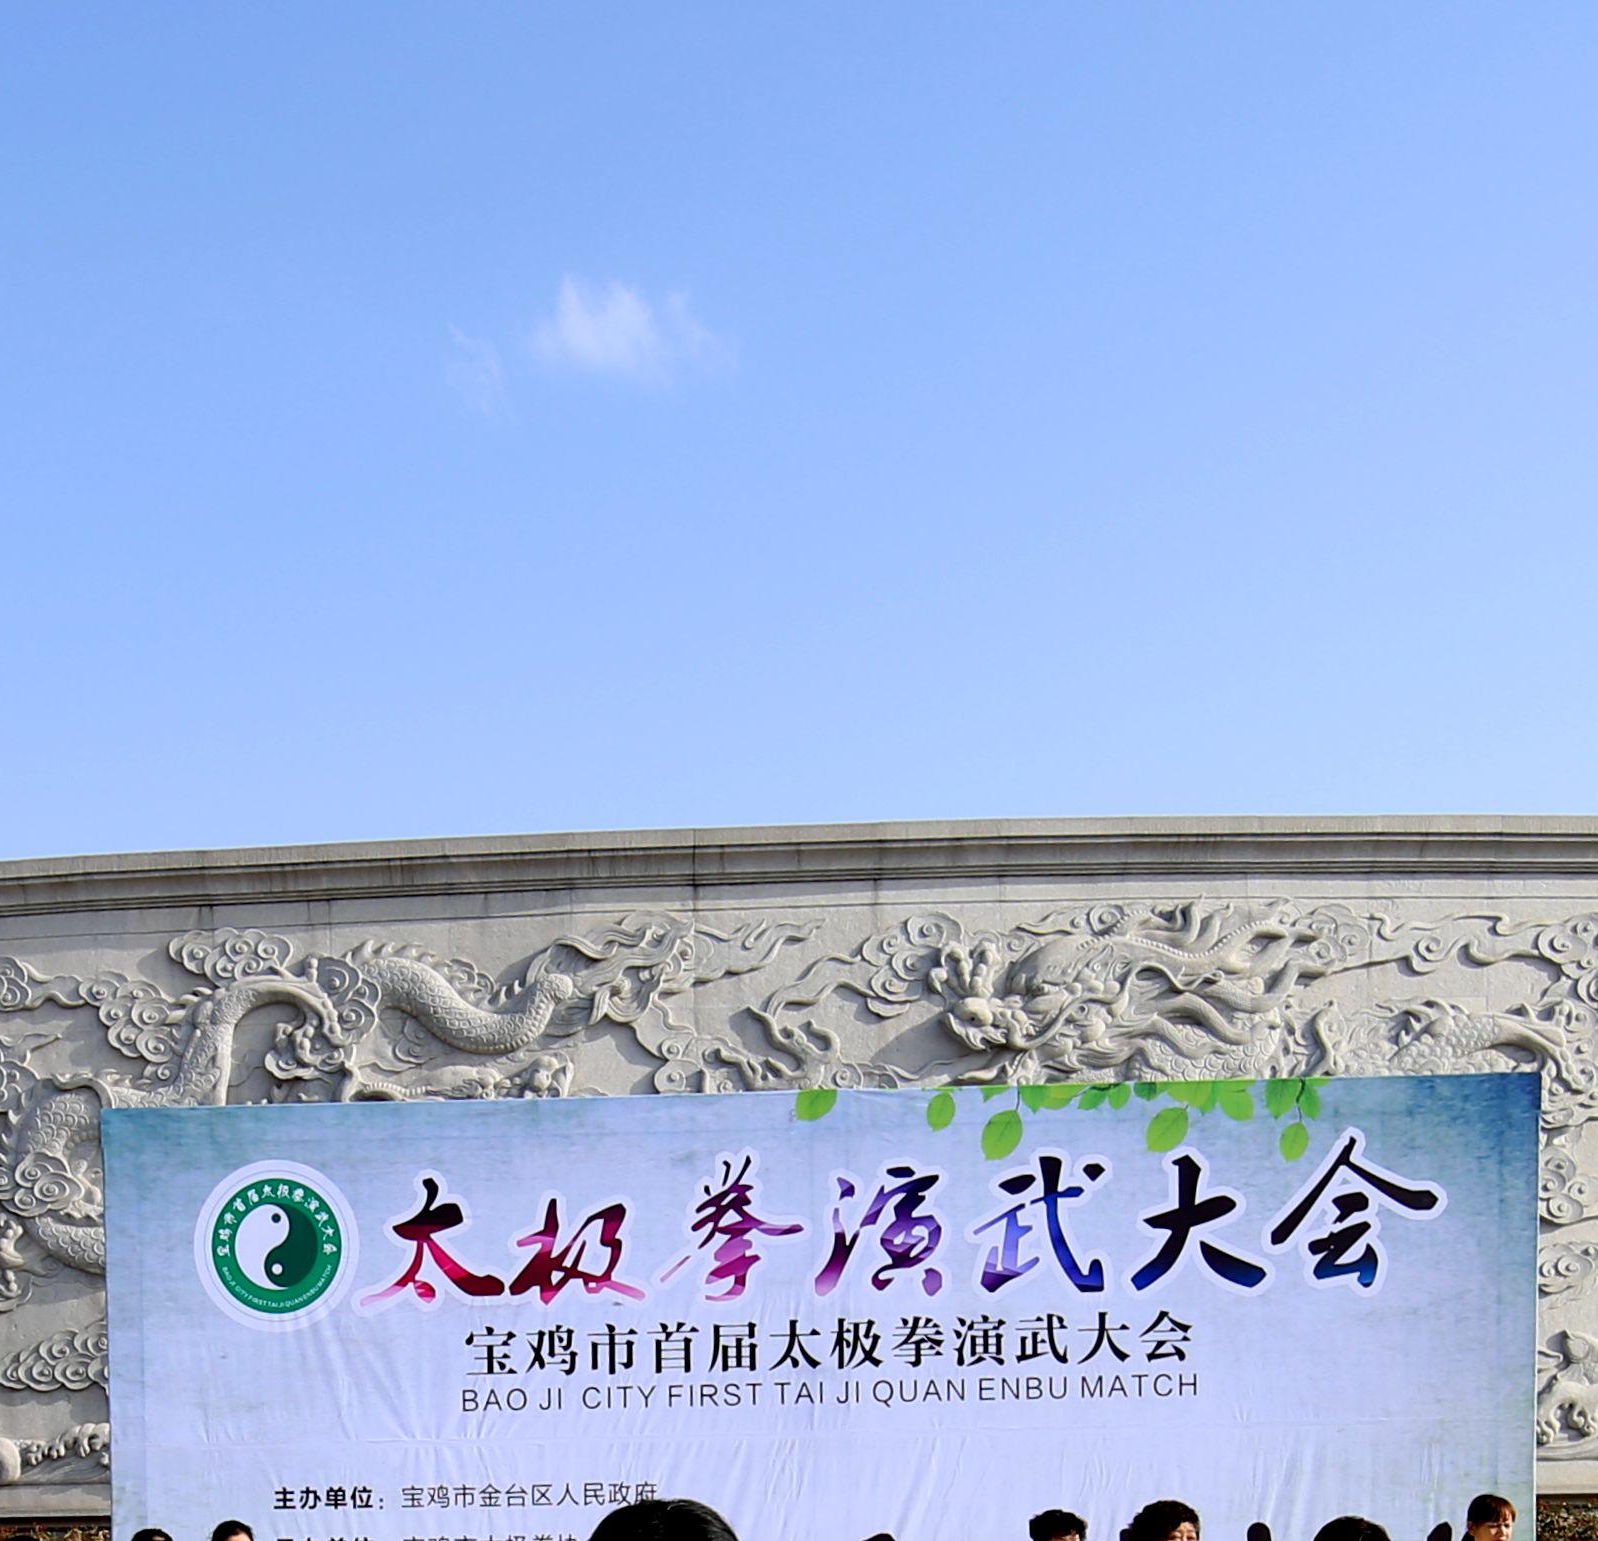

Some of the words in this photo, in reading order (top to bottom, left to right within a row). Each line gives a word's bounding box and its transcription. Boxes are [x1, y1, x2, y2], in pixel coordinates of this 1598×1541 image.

[360, 1136, 1439, 1306] 太极拳演武大会
[465, 1310, 1193, 1376] 宝鸡市首届太极拳演武大会
[462, 1388, 528, 1412] BAO
[539, 1387, 562, 1411] JI
[582, 1384, 656, 1410] CITY
[668, 1382, 763, 1408] FIRST
[774, 1381, 824, 1406] TAI
[837, 1380, 860, 1404] JI
[872, 1378, 965, 1408] QUAN
[978, 1376, 1068, 1401] ENBU
[1080, 1373, 1198, 1399] MATCH
[402, 1481, 658, 1509] 宝鸡市金台区人民政府
